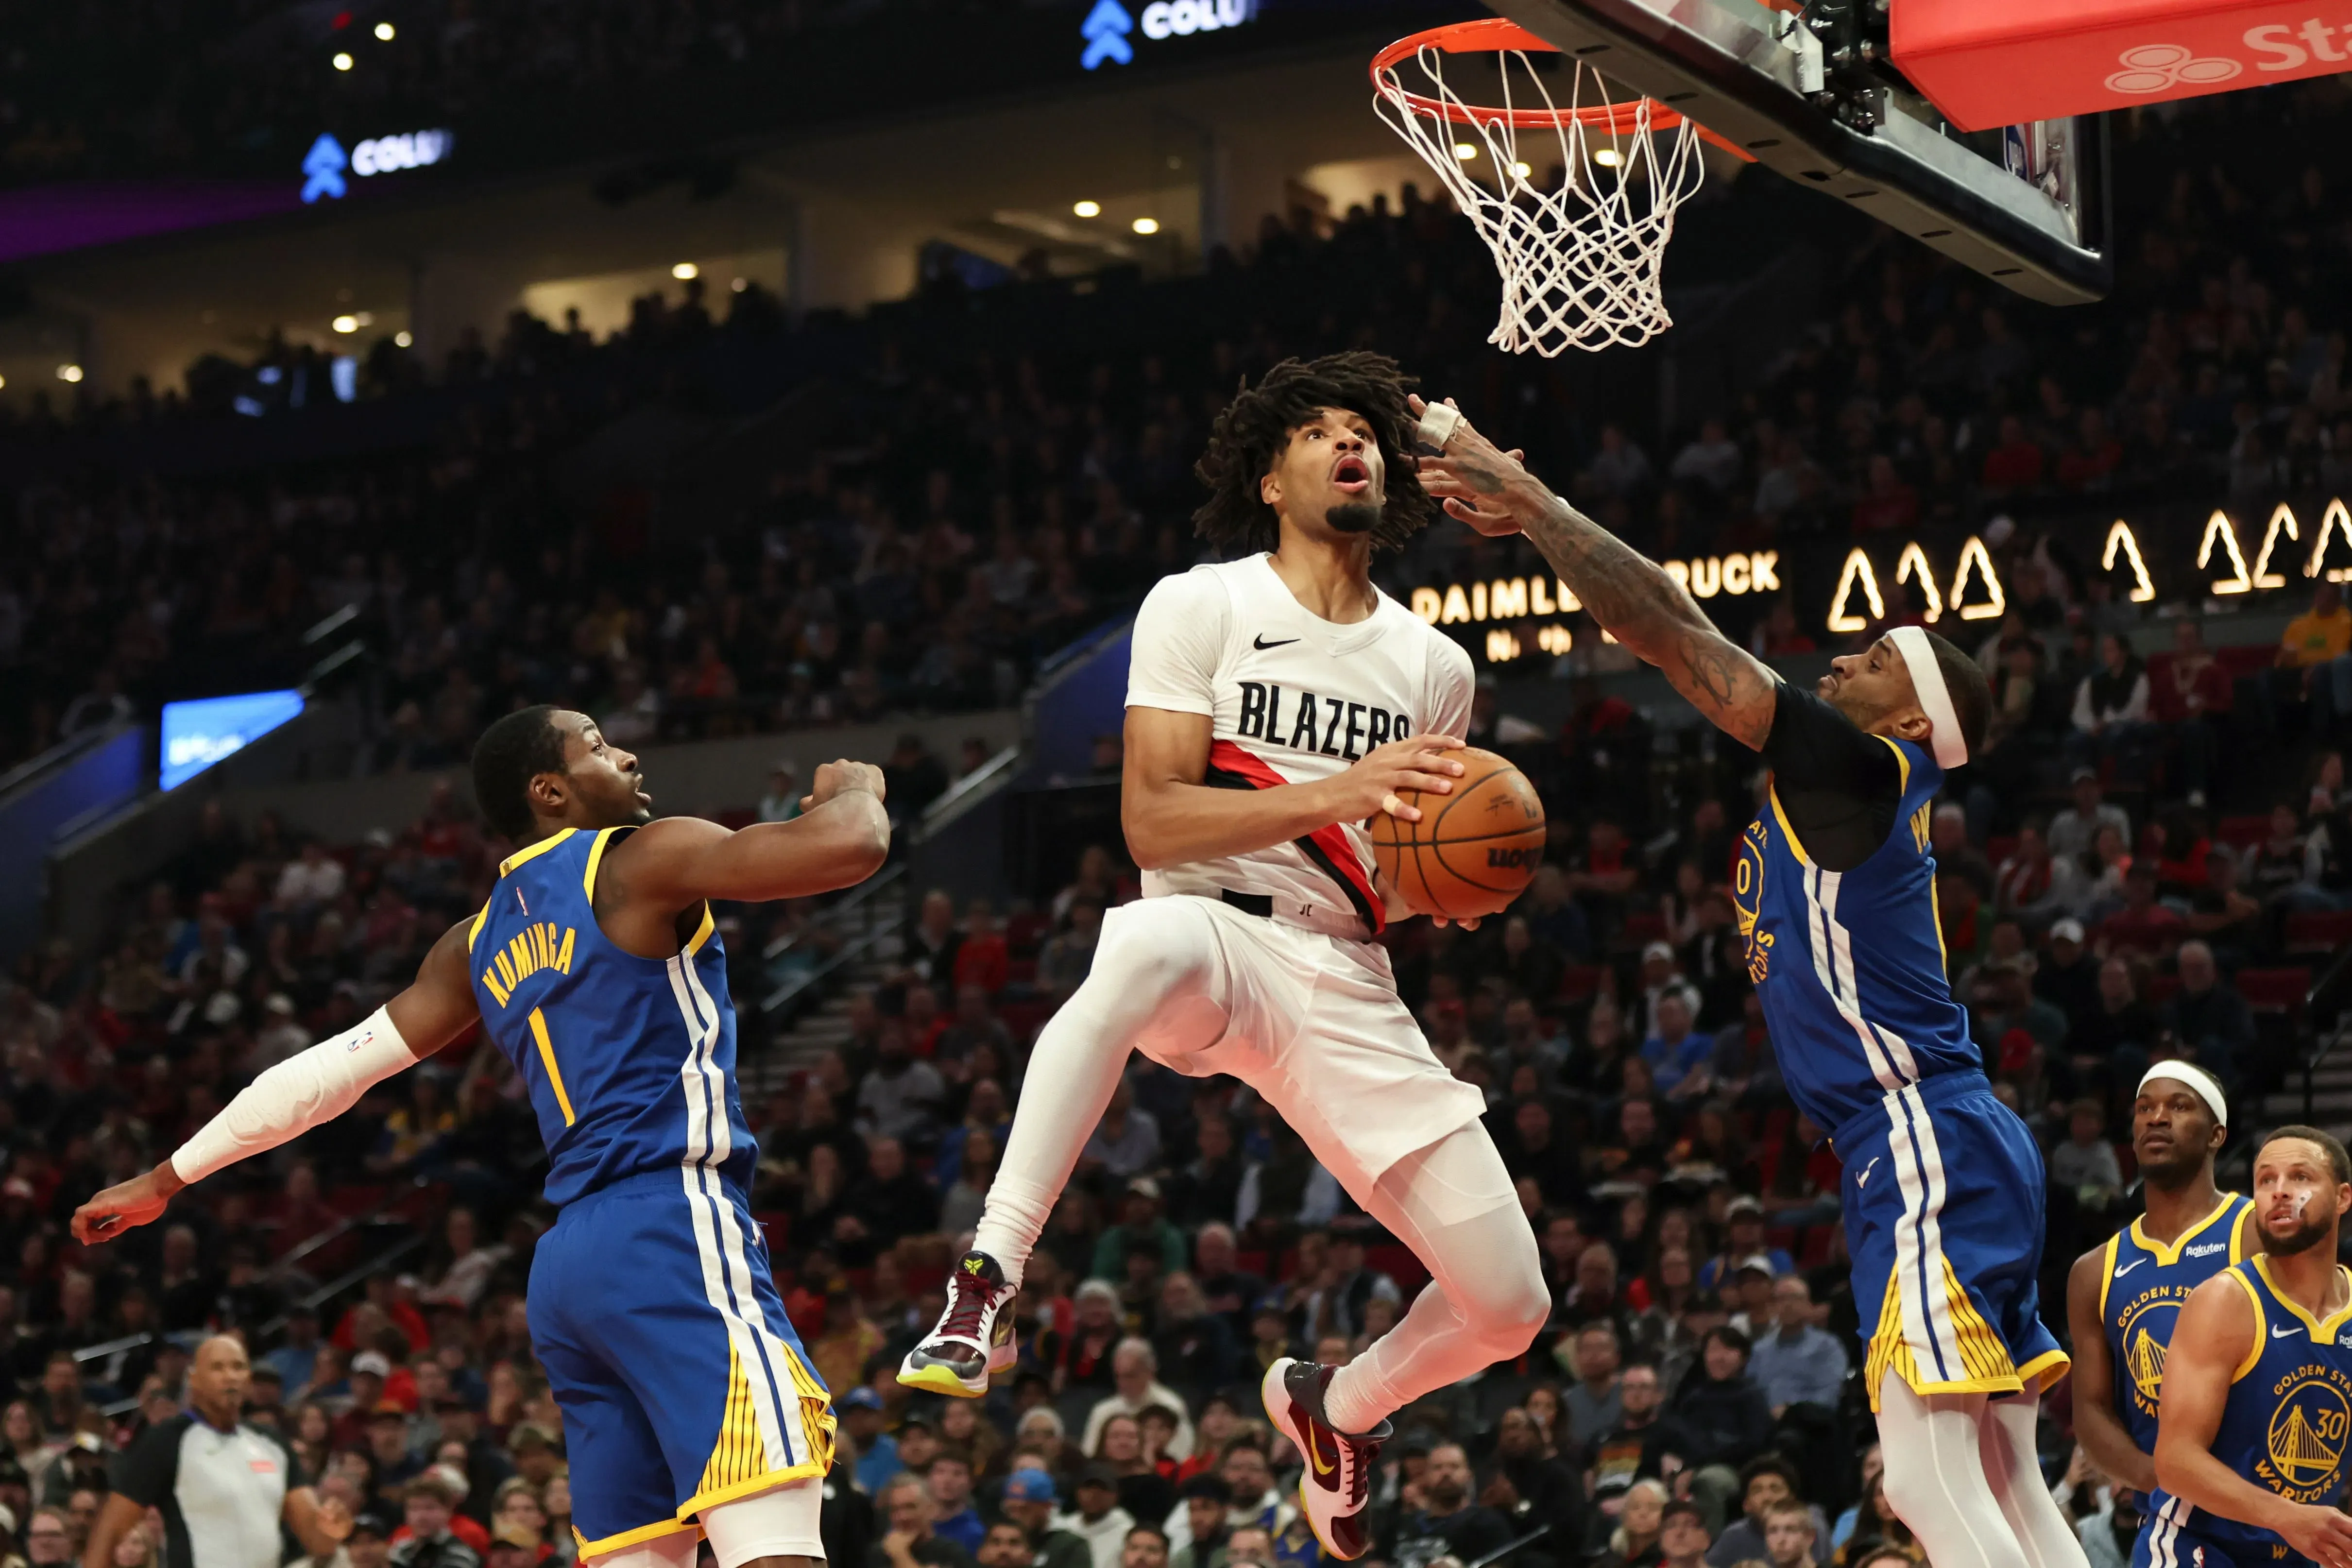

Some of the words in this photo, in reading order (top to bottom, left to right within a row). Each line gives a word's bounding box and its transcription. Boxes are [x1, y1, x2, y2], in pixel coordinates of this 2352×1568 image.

[482, 922, 576, 1009] KUMINGA
[528, 1006, 575, 1127] 1
[2186, 1243, 2226, 1257] Rakuten
[2118, 1286, 2169, 1328] GOLDEN
[2274, 1364, 2326, 1396] GOLDEN
[2330, 1370, 2352, 1398] STA
[2134, 1389, 2160, 1420] WA
[2316, 1408, 2345, 1440] 30
[2255, 1459, 2341, 1503] WARIORS
